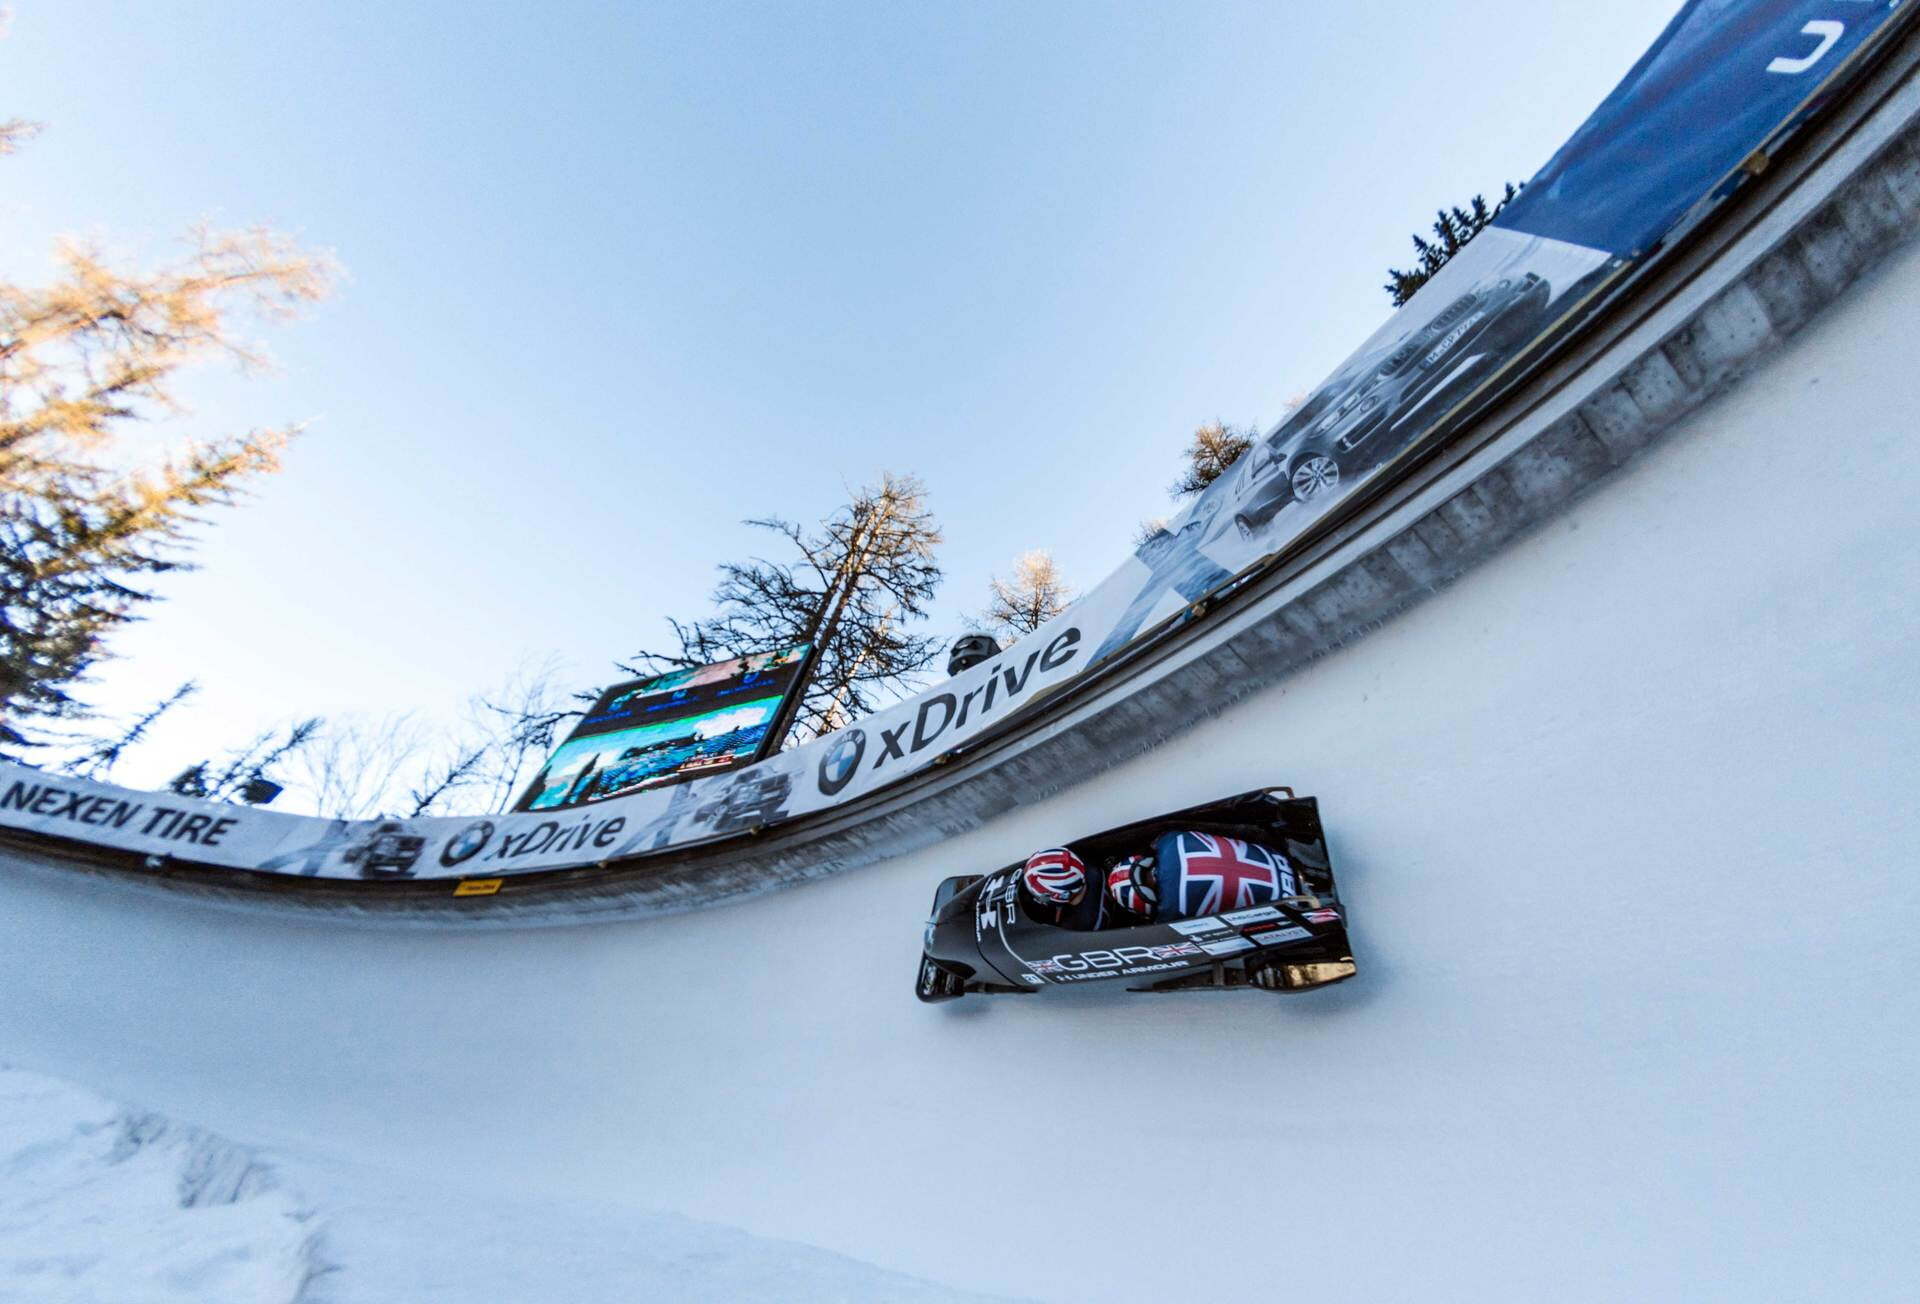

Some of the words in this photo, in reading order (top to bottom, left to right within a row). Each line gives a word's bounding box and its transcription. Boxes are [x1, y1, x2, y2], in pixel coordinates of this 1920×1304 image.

[872, 626, 1081, 770] xDrive
[0, 780, 143, 829] NEXEN
[140, 807, 238, 846] TIRE
[485, 814, 627, 861] xDrive
[1052, 946, 1163, 971] GBR
[1072, 970, 1119, 980] UNDER
[1122, 960, 1190, 975] ARMOUR
